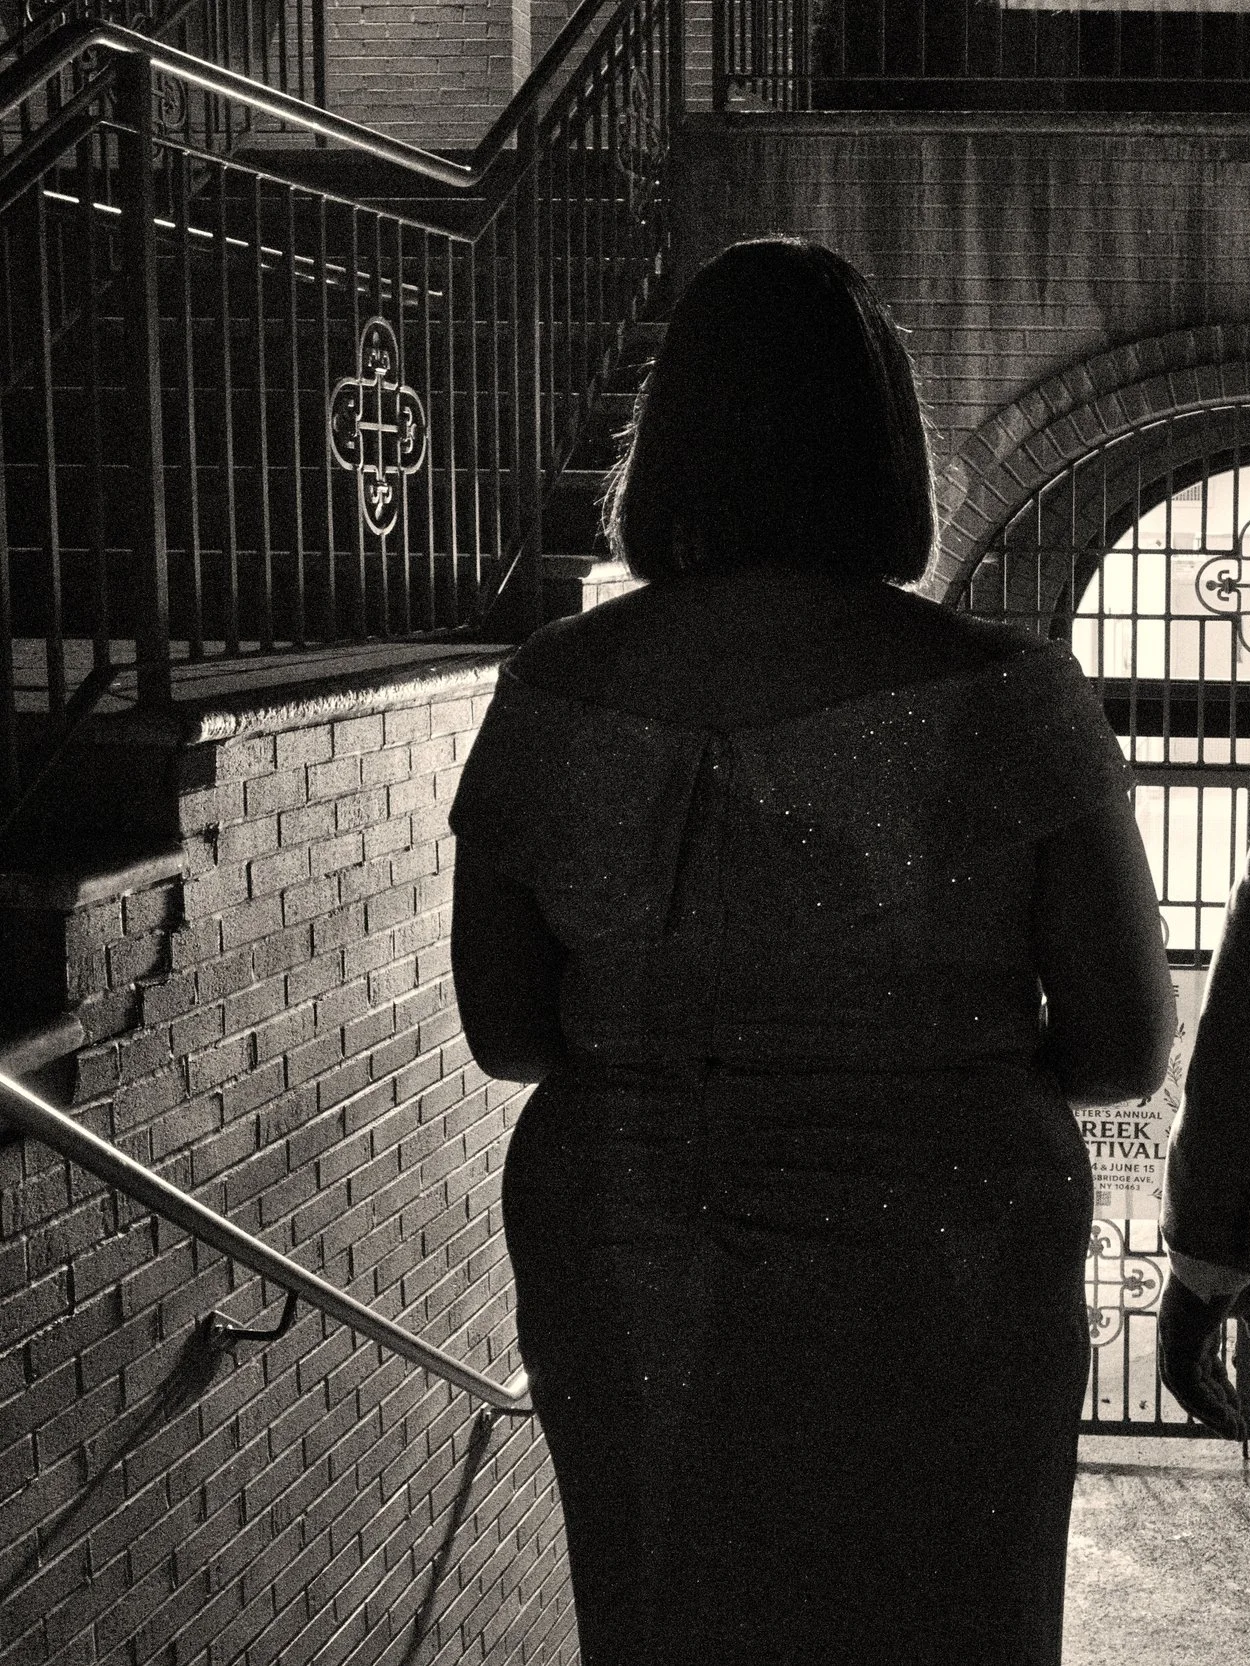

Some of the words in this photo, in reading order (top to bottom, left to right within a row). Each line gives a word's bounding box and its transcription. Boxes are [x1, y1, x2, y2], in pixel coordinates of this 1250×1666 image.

[1074, 1109, 1111, 1118] ETER'S
[1115, 1111, 1162, 1120] ANNUAL
[1081, 1120, 1151, 1140] REEK
[1085, 1140, 1166, 1160] TIVAL
[1109, 1163, 1140, 1173] JUNE
[1143, 1164, 1155, 1173] 15
[1133, 1176, 1154, 1184] AVE,
[1099, 1182, 1112, 1190] NY
[1115, 1183, 1140, 1191] 10463
